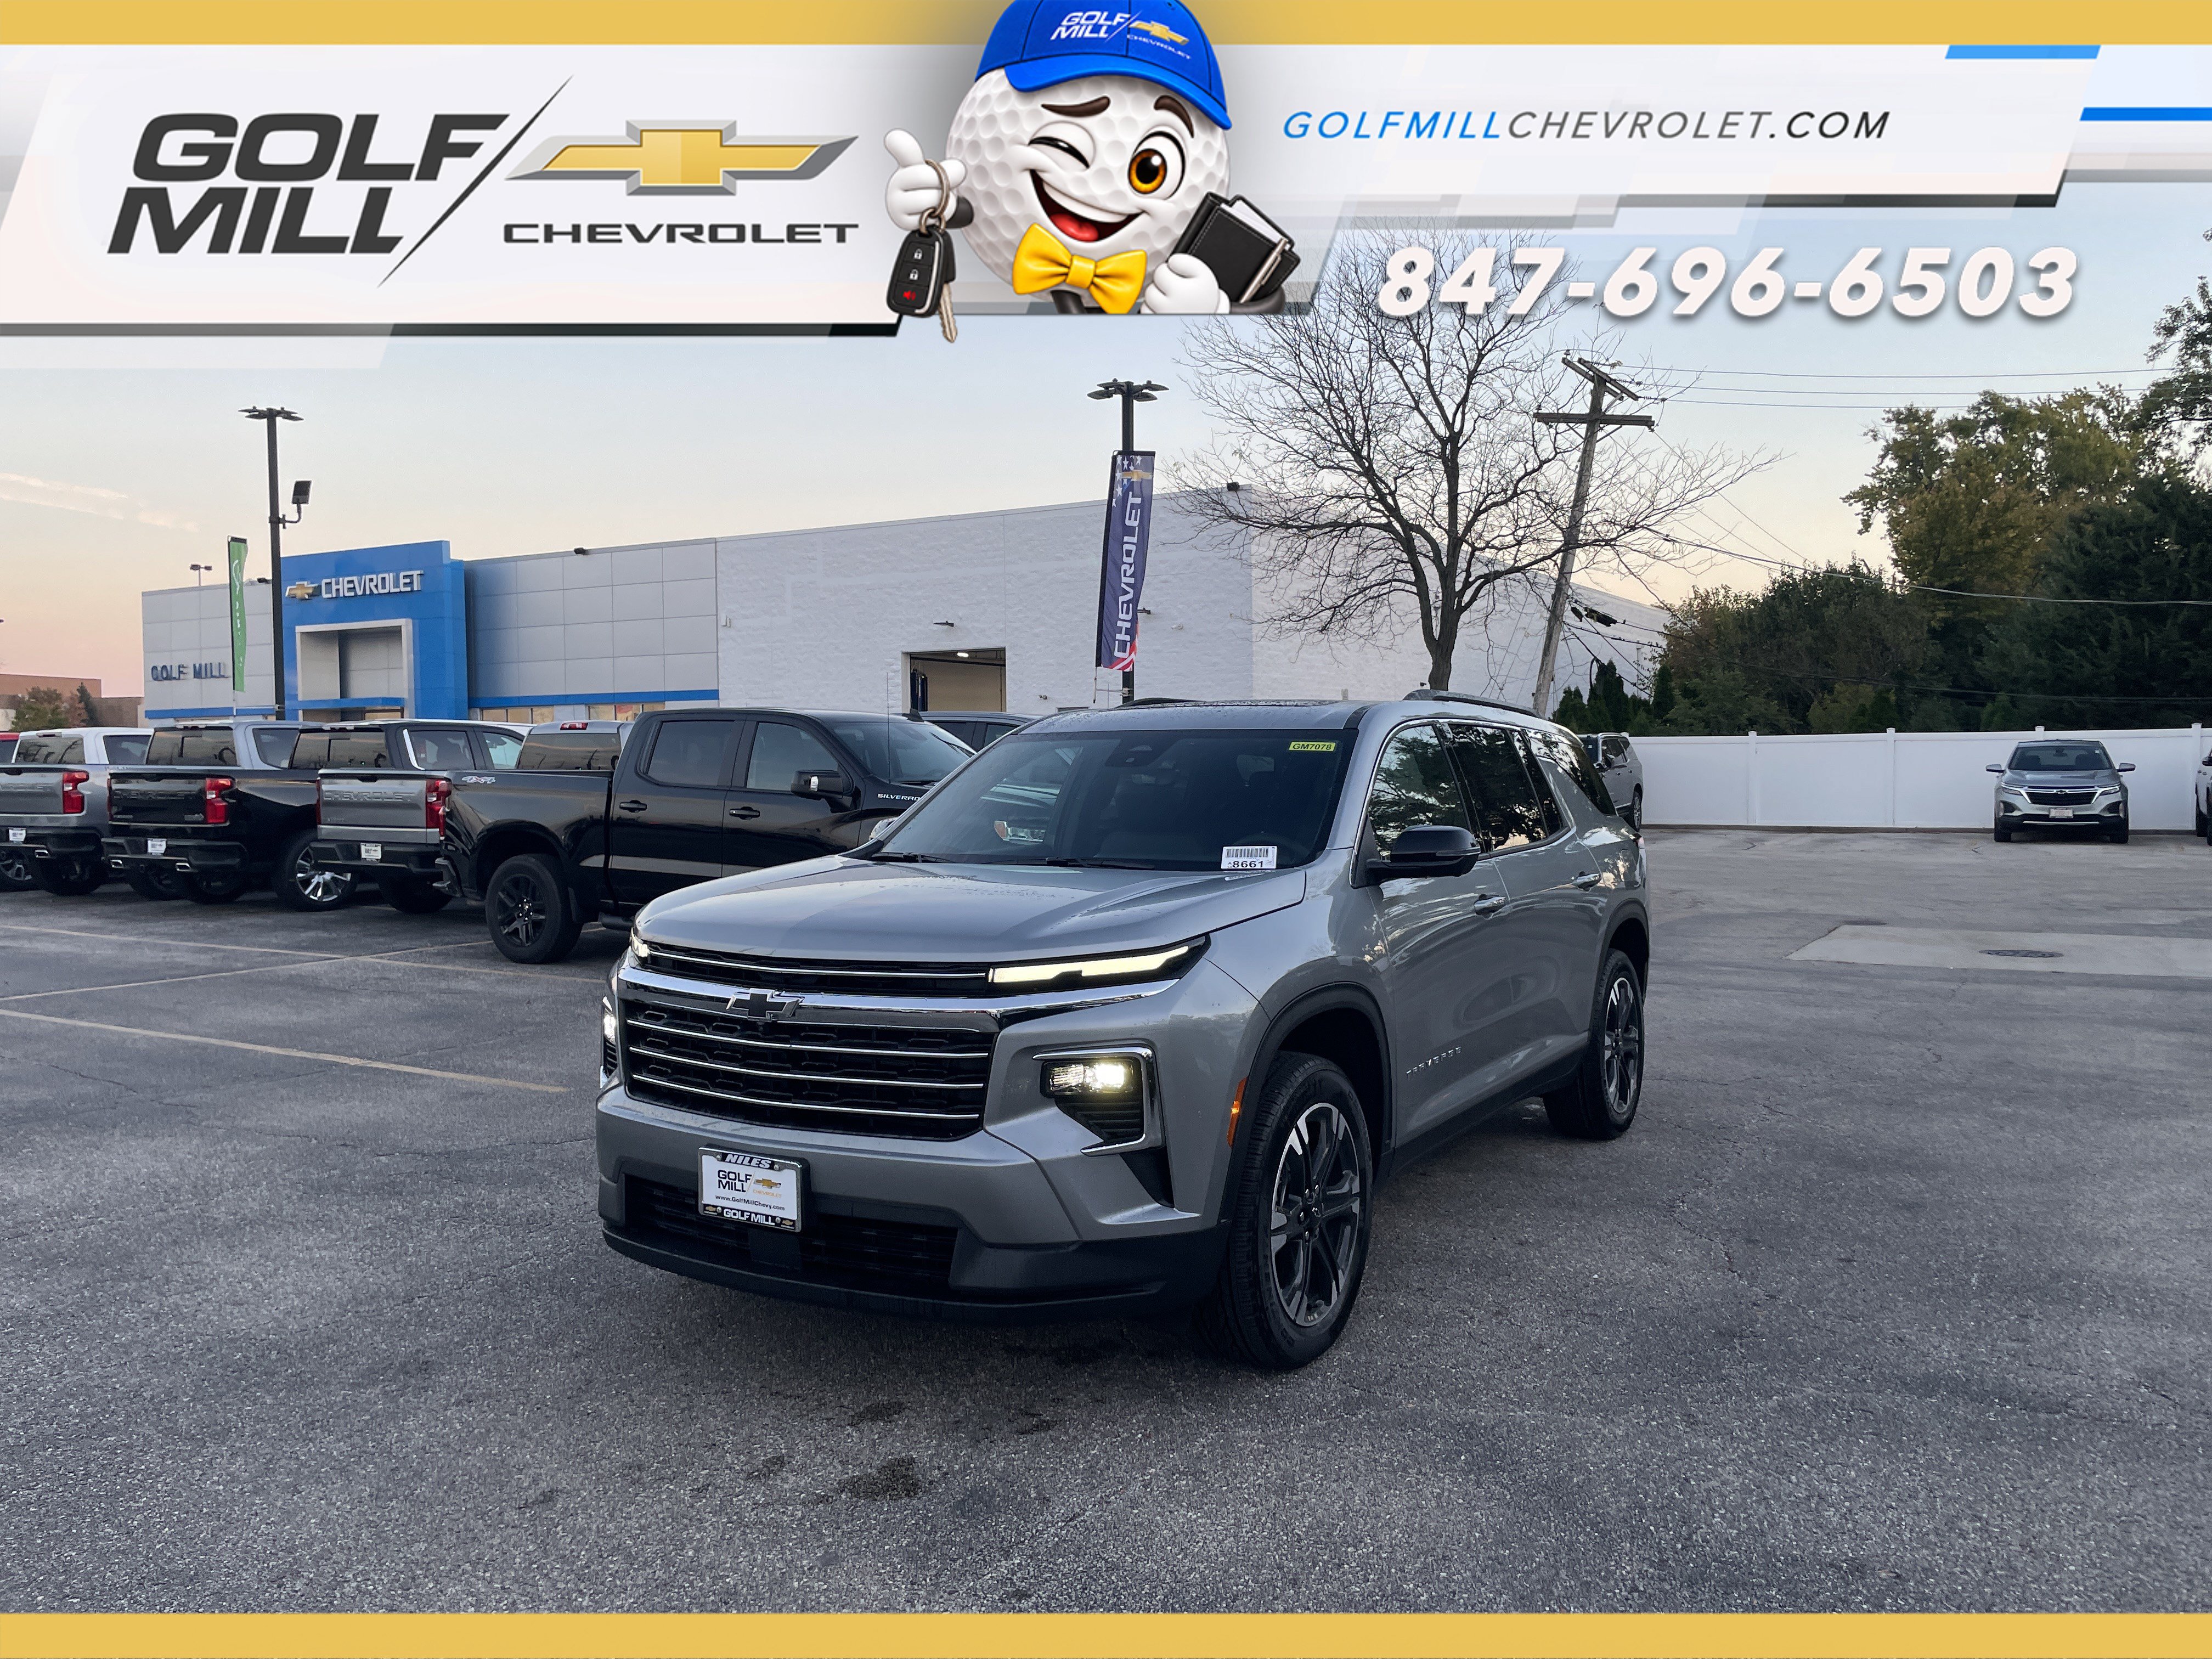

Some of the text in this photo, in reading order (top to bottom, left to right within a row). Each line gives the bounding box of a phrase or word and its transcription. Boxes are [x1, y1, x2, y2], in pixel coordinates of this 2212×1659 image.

[1114, 491, 1142, 658] CHEVROLET
[322, 570, 424, 598] CHEVROLET
[193, 662, 229, 679] MILL
[878, 793, 922, 802] SILVERAD
[725, 1154, 772, 1169] NILES
[718, 1170, 752, 1183] GOLF
[718, 1180, 747, 1193] MILL
[715, 1194, 785, 1211] www.GolfMillChevy.com
[723, 1209, 750, 1221] GOLF
[751, 1213, 775, 1226] MILL
